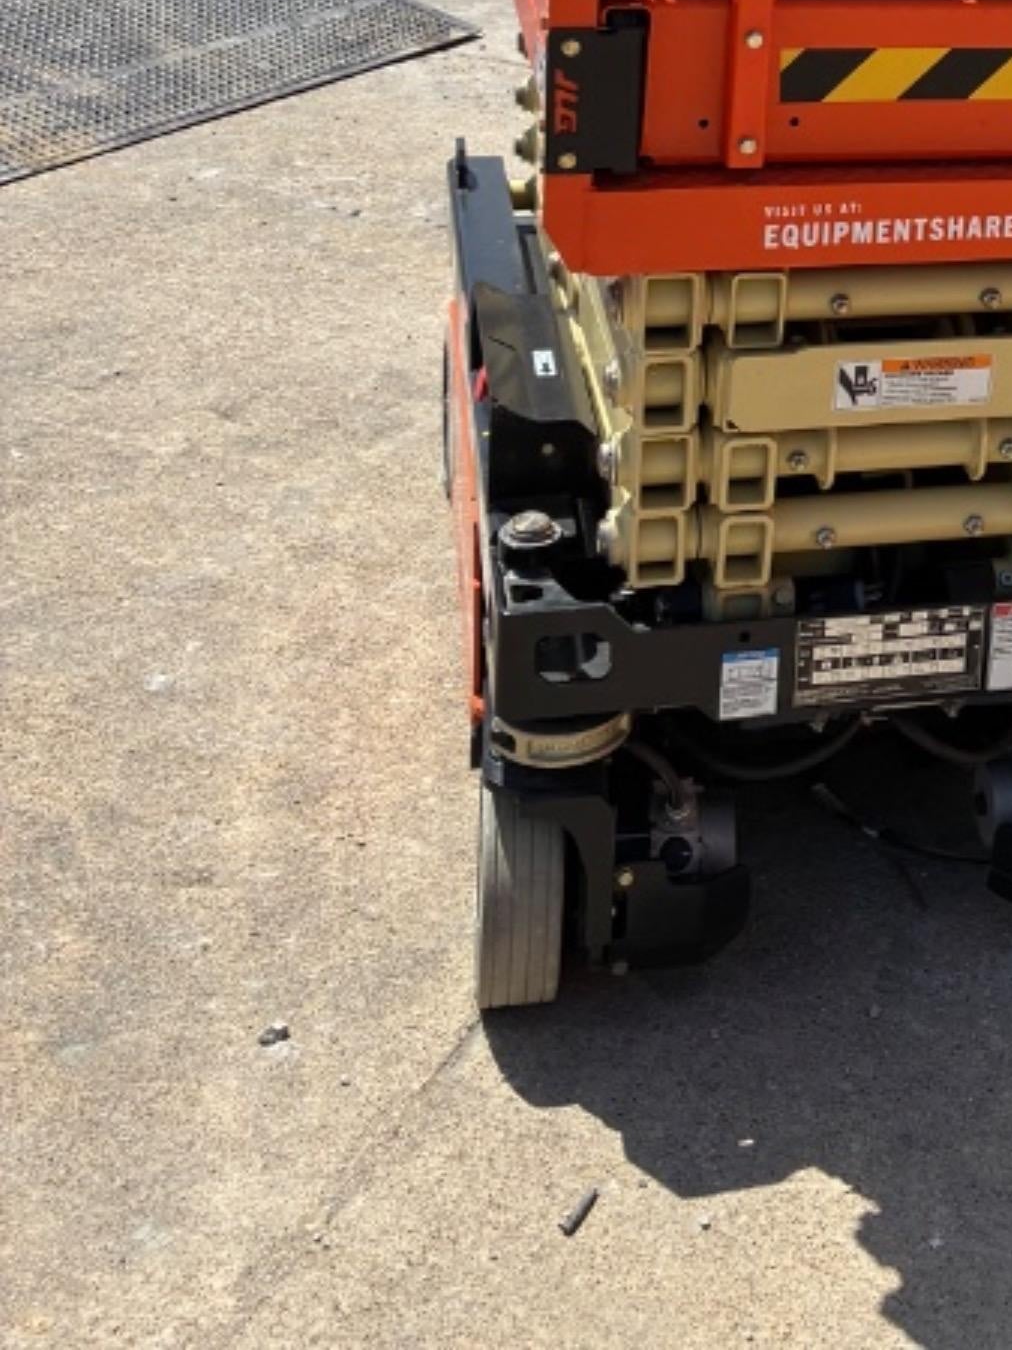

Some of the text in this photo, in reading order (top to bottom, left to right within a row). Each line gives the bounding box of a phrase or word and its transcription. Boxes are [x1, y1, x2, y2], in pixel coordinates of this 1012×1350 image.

[553, 69, 580, 136] JLG
[763, 202, 863, 219] VISIT US AT:
